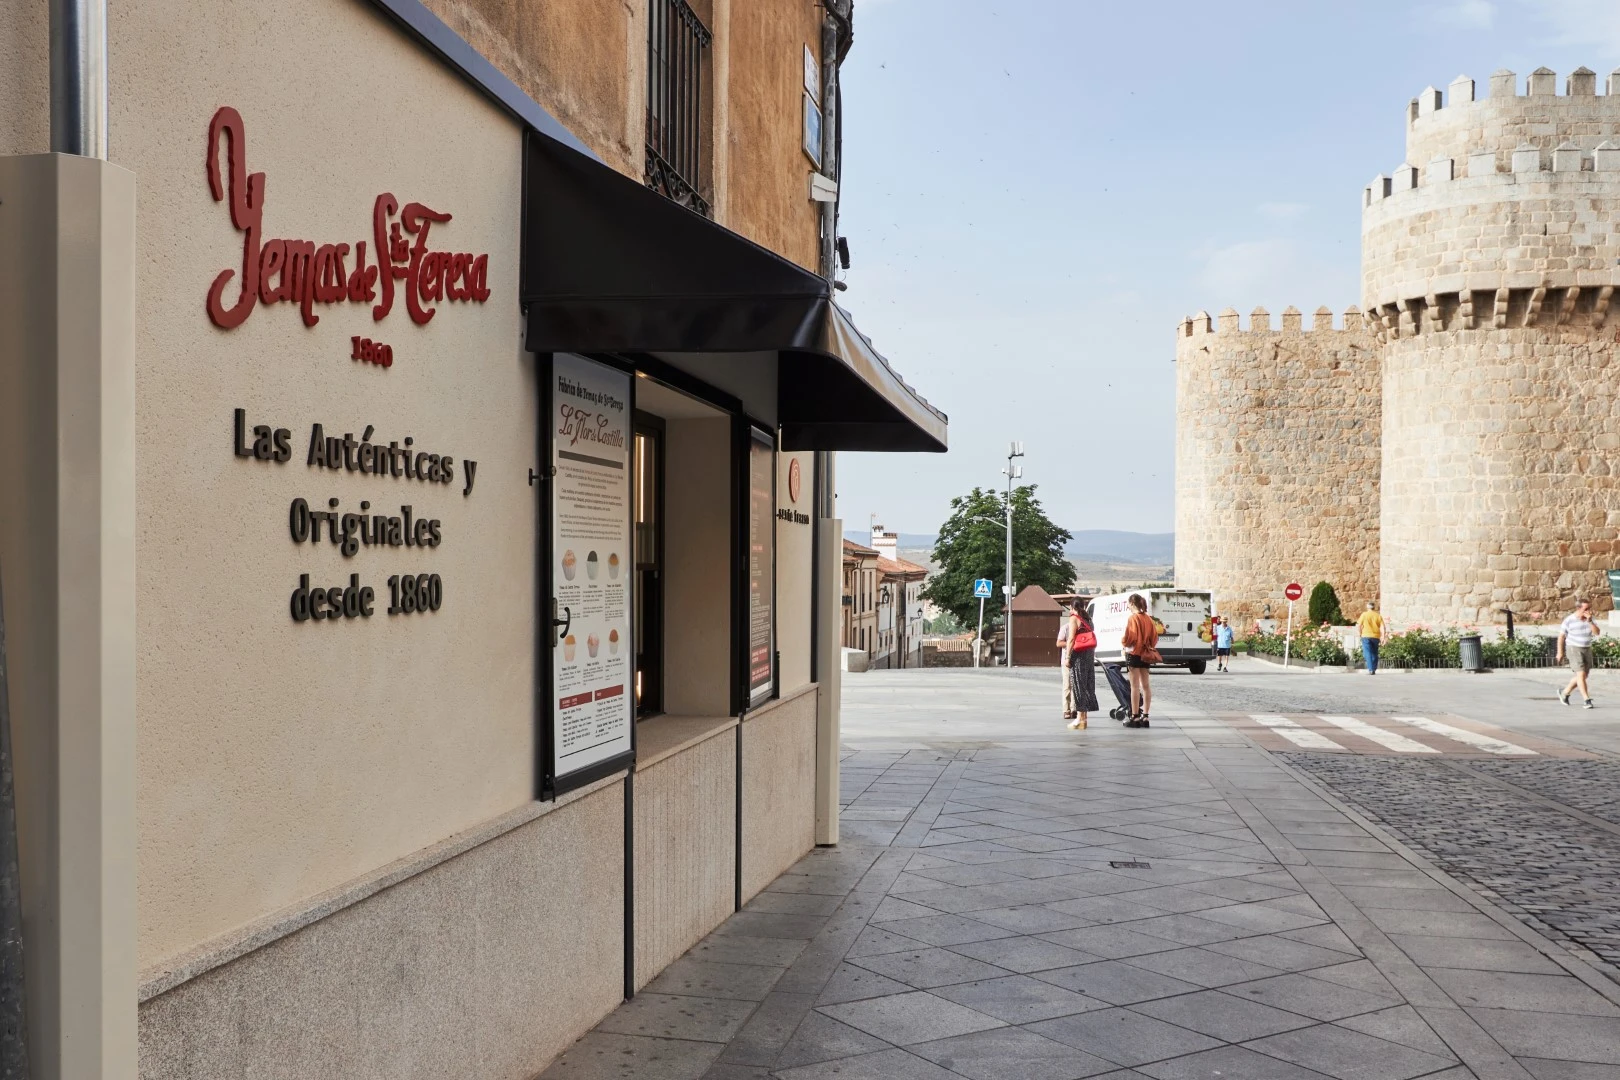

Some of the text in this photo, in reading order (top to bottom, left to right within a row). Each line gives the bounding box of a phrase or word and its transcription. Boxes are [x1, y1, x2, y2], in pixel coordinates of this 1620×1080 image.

[206, 106, 350, 329] Yemas
[348, 241, 378, 302] de
[401, 202, 491, 325] Teresa
[351, 335, 394, 367] 1860
[559, 403, 574, 436] La
[570, 409, 593, 447] Flor
[597, 413, 624, 448] Castilla
[234, 408, 478, 496] Las Auténticas y
[290, 497, 442, 557] Originales
[290, 573, 443, 622] desde 1860
[1110, 600, 1130, 614] FRUTA
